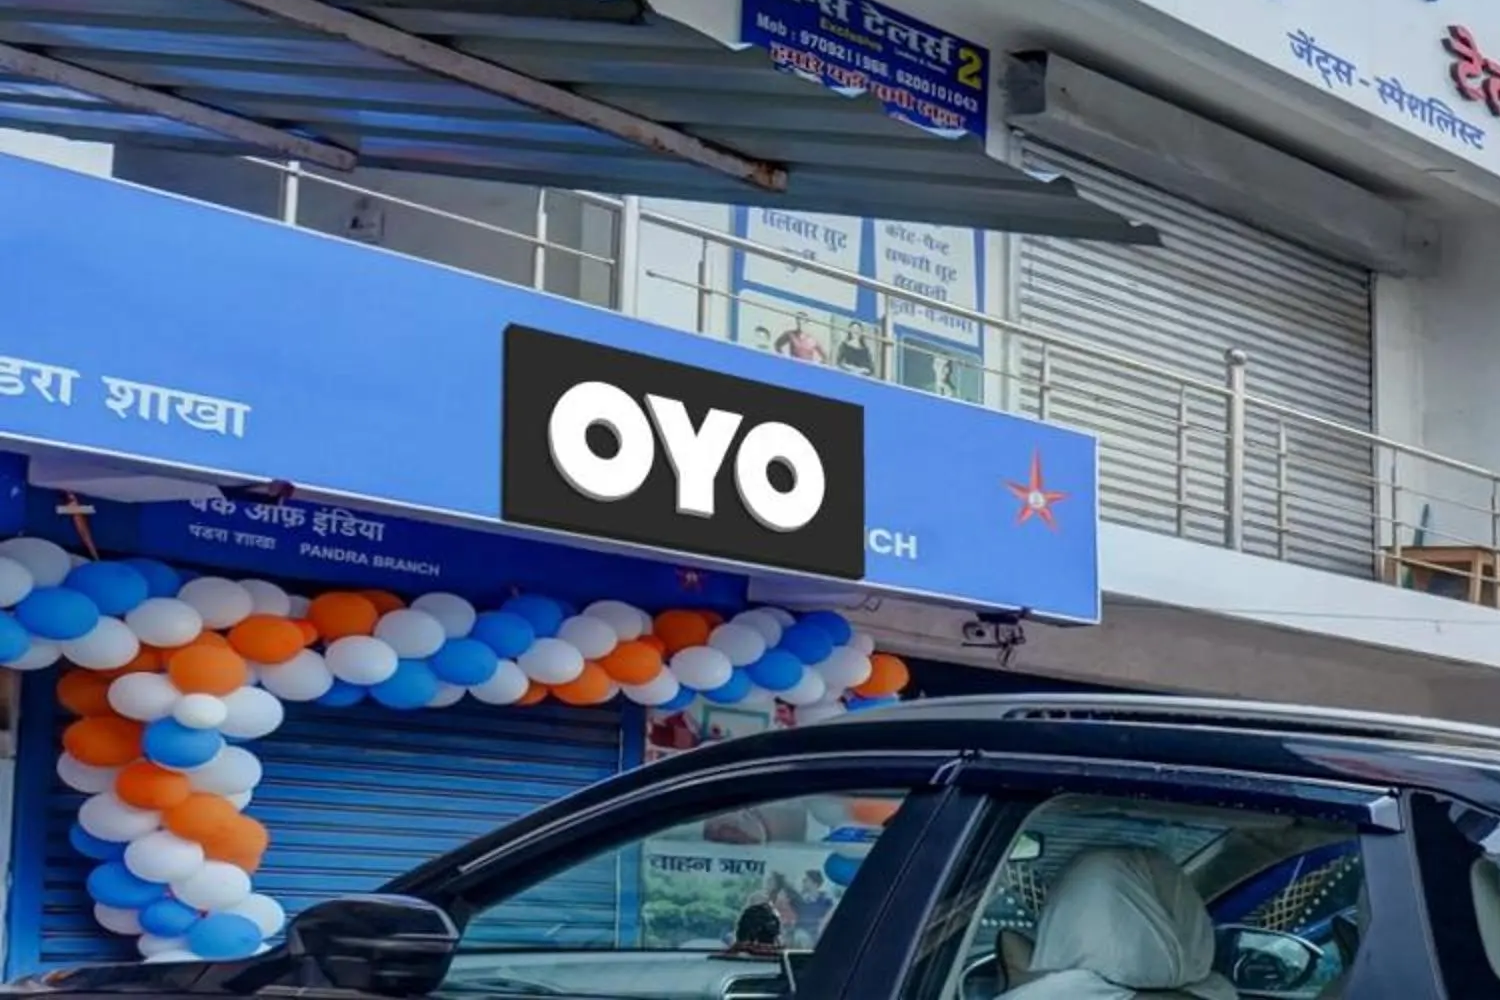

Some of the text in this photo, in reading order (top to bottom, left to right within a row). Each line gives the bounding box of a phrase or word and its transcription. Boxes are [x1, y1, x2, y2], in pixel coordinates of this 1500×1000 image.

[957, 47, 983, 90] 2
[101, 375, 252, 439] शाखा
[547, 381, 826, 533] OYO
[300, 542, 440, 577] PANDRA BRANCH
[864, 525, 918, 560] CH
